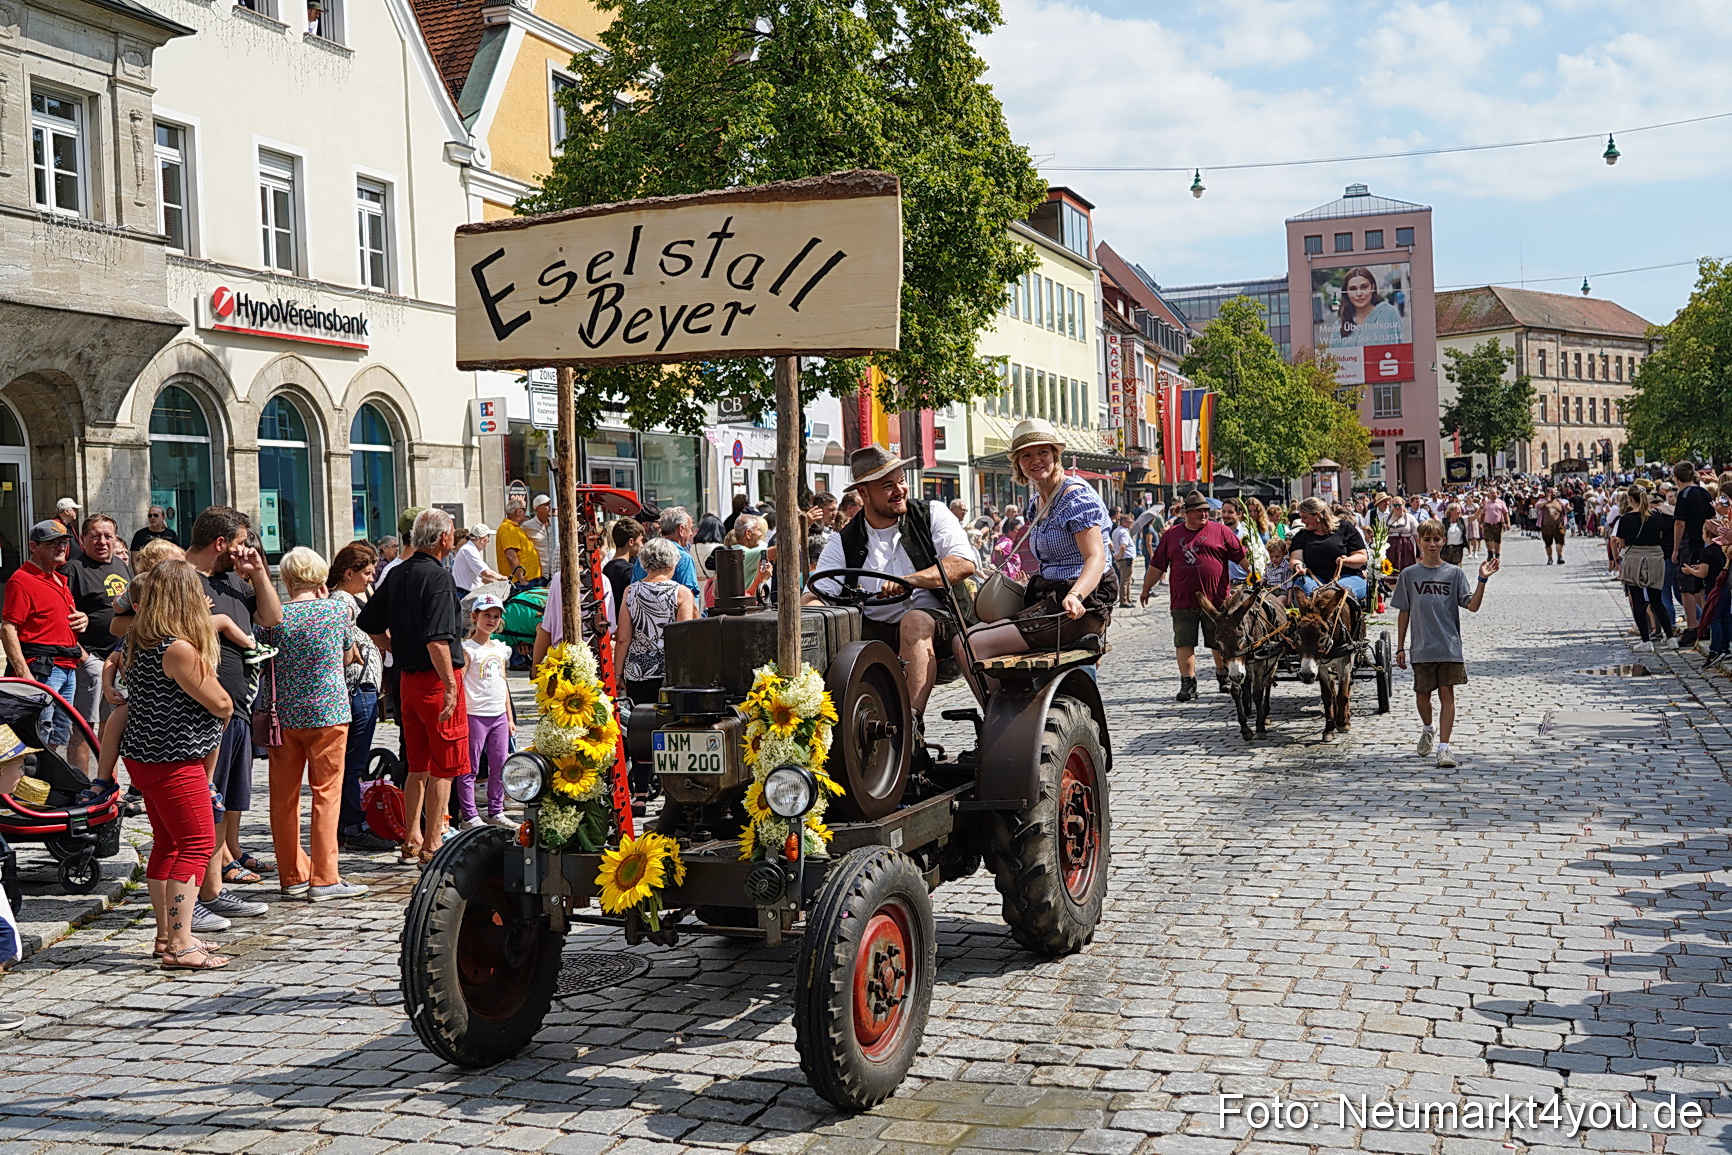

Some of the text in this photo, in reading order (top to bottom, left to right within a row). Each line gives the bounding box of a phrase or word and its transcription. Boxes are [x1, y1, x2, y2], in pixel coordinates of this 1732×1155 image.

[236, 291, 369, 336] HypoVereinsbank
[578, 282, 756, 352] Beyer
[1319, 324, 1341, 333] Mehr
[1319, 336, 1356, 345] Weniger
[539, 370, 556, 381] ZONE
[720, 397, 743, 413] CB
[717, 414, 748, 422] Parfümerie
[1413, 581, 1451, 596] VANS
[667, 734, 690, 751] NM
[657, 753, 720, 772] WW 200
